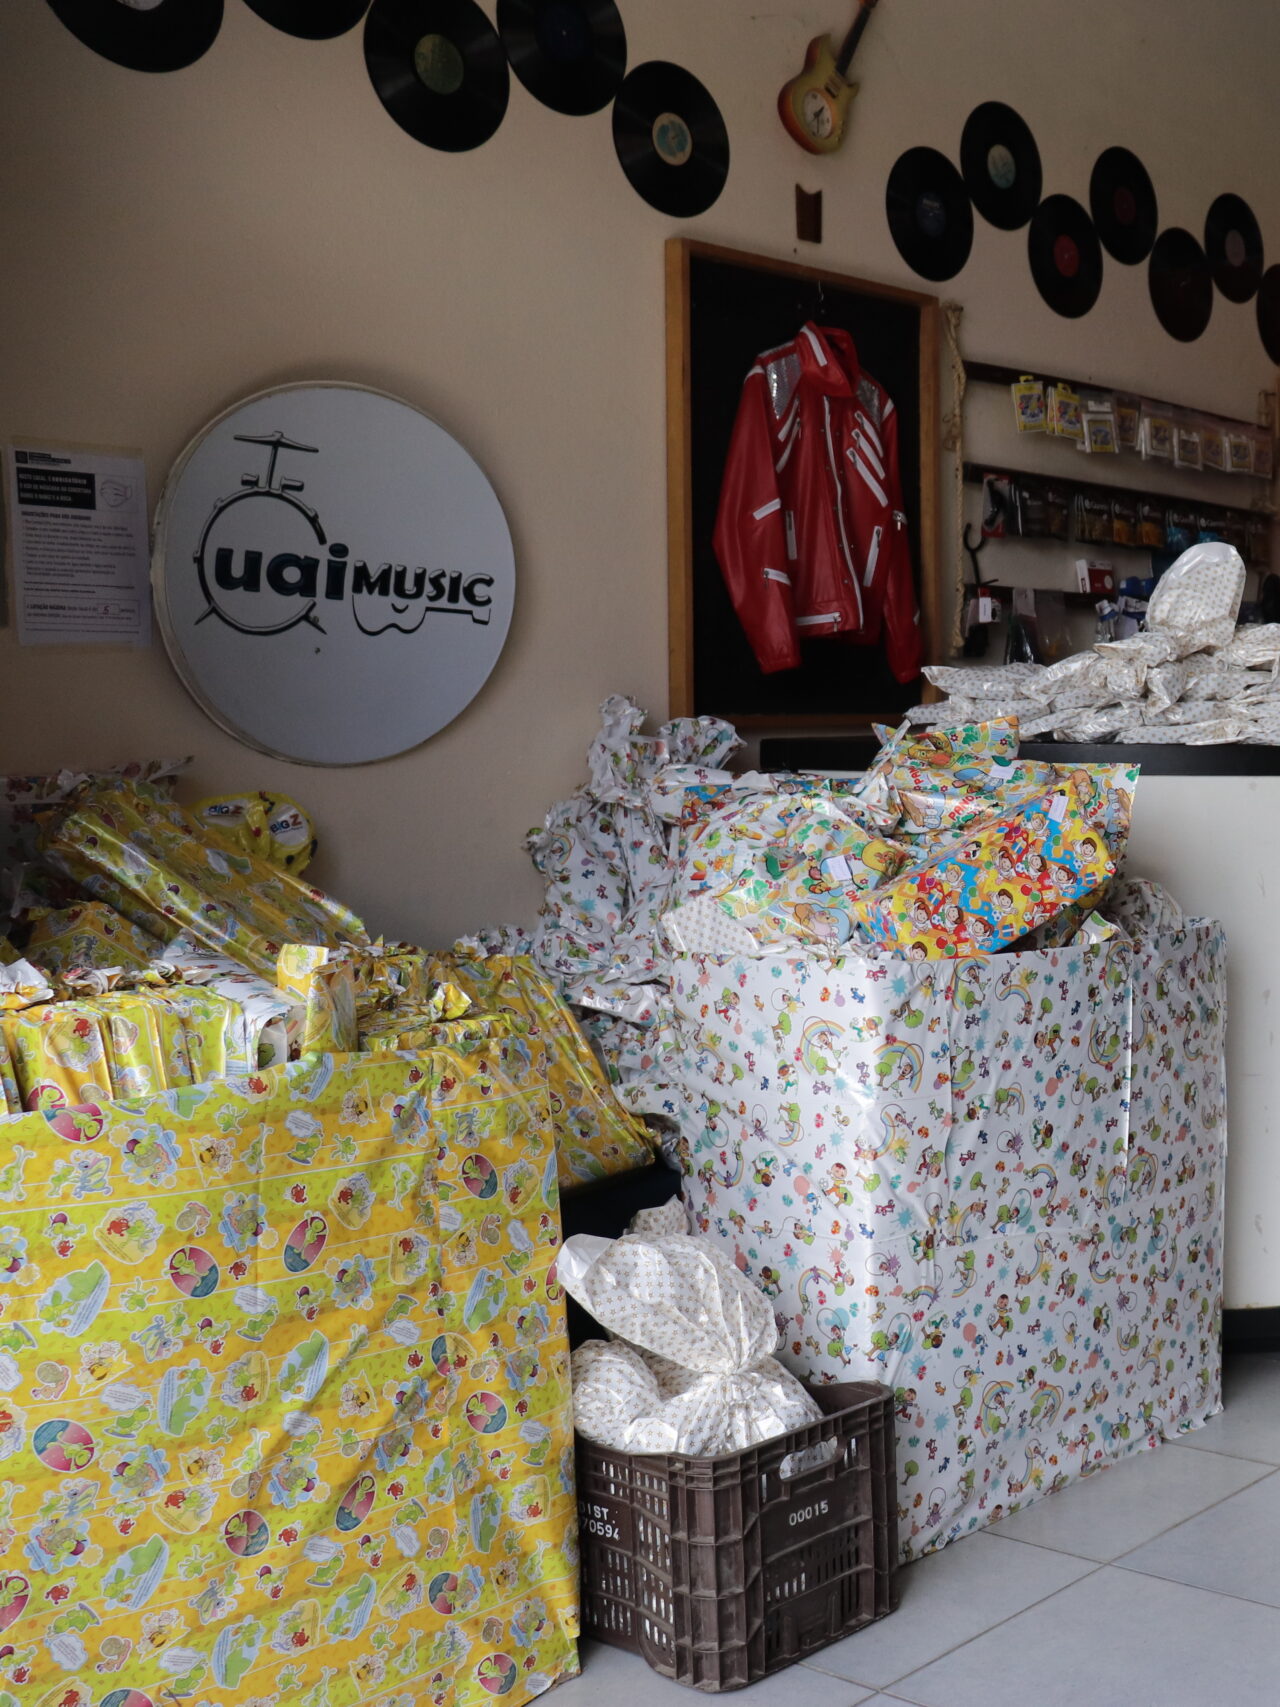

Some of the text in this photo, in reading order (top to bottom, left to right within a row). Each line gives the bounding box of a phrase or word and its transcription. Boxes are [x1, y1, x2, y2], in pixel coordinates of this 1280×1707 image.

[214, 542, 495, 607] uai MUSIC
[788, 1500, 829, 1526] 00015
